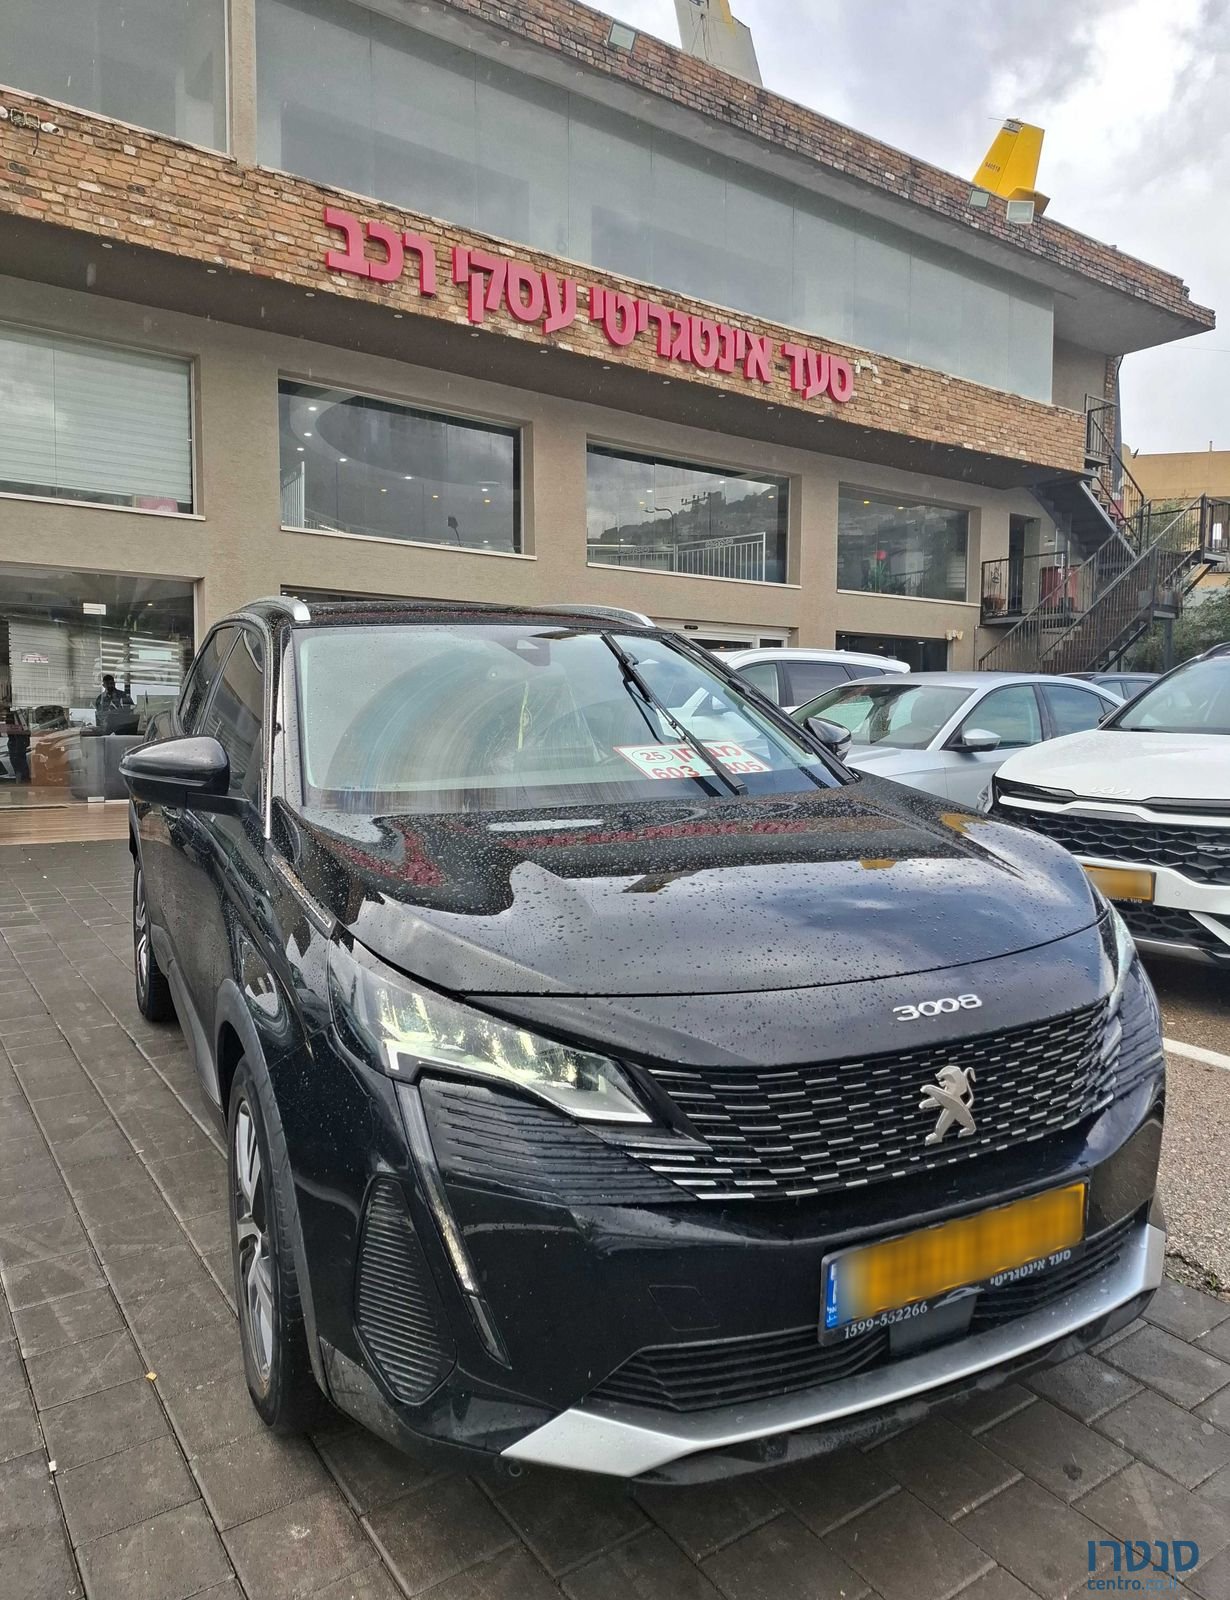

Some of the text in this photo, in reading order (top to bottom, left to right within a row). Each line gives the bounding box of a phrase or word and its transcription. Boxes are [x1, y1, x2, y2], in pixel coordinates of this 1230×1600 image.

[323, 206, 855, 402] סעד אינטגריטי עסקי רכב
[640, 751, 666, 761] 25
[892, 993, 983, 1022] 3008
[990, 1249, 1072, 1287] סעד אינטגריטי
[844, 1301, 928, 1340] 1599-552266
